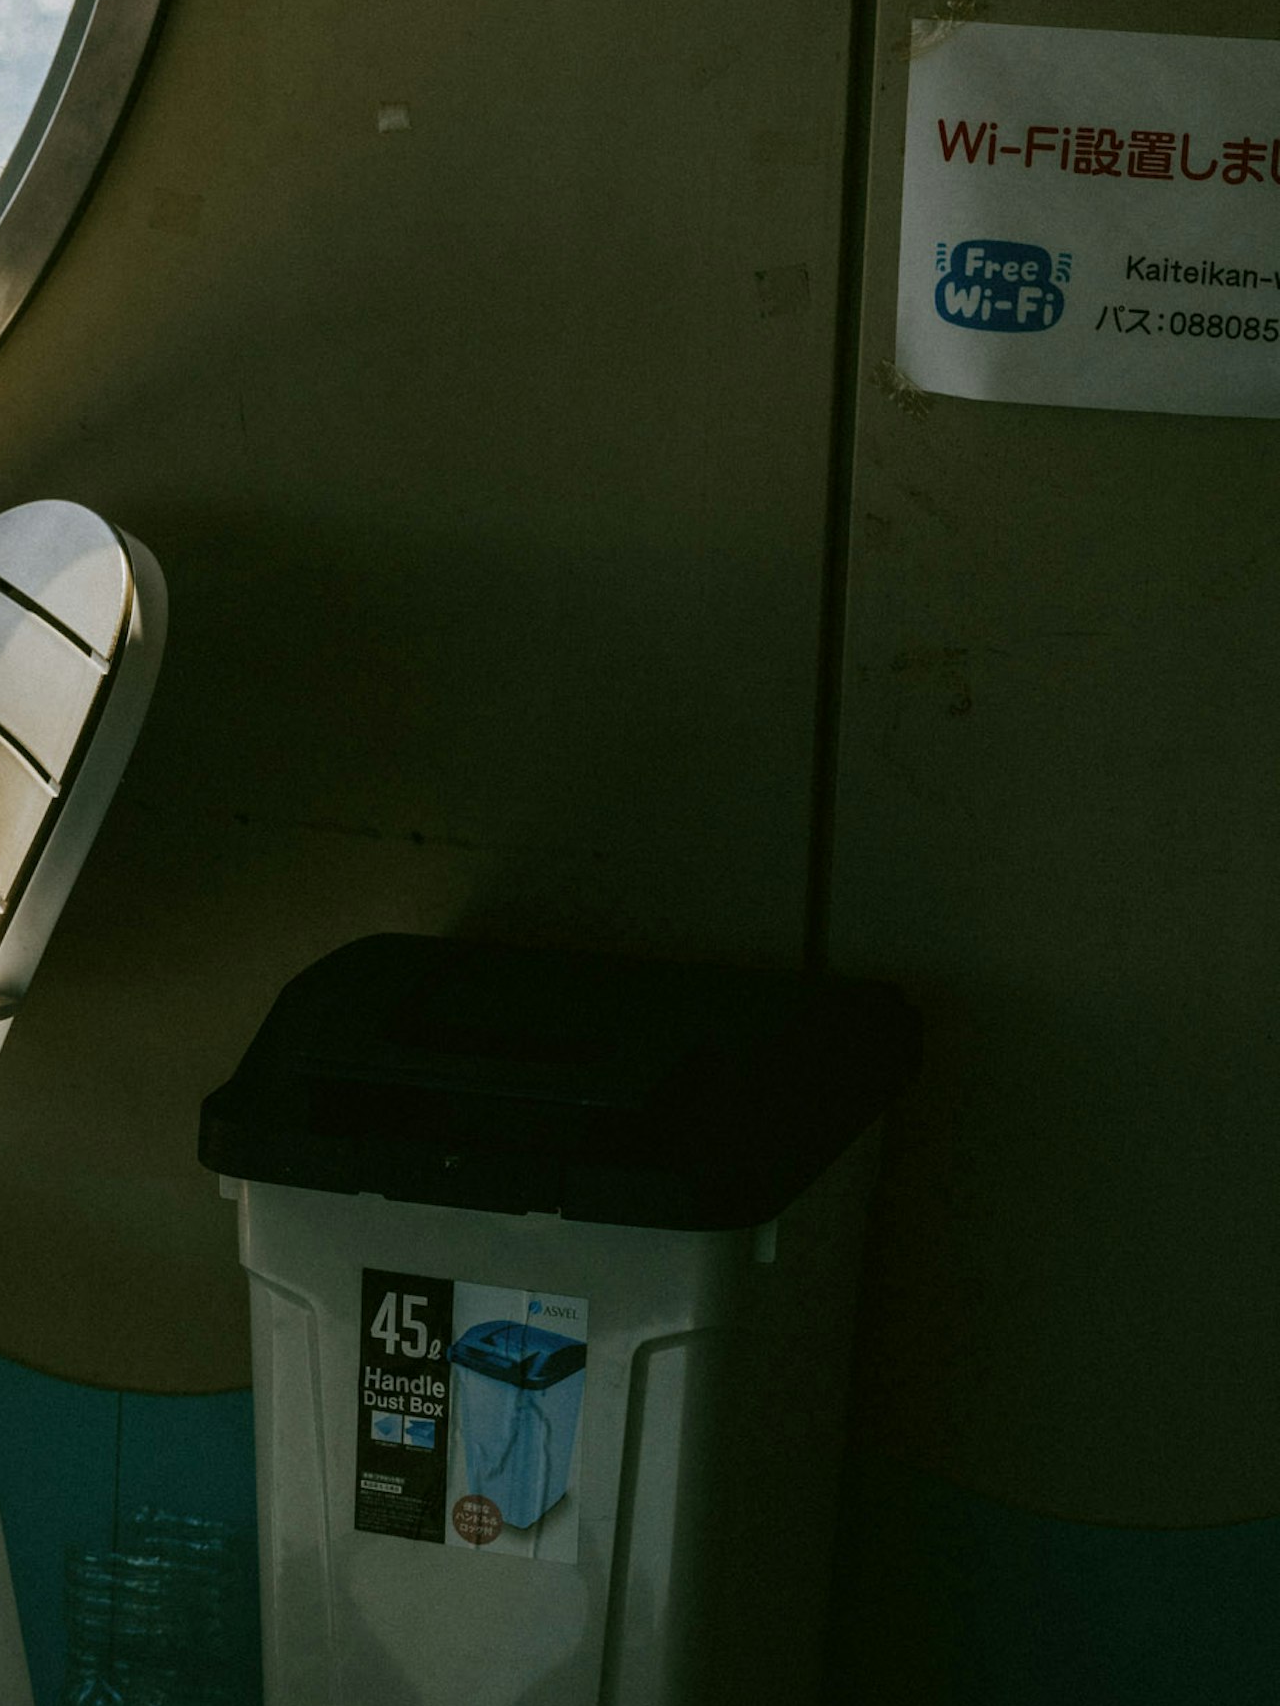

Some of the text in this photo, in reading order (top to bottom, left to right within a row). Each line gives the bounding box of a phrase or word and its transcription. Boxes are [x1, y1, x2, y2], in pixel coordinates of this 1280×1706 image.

[938, 119, 1280, 186] Wi-Fi設置しま
[965, 248, 1039, 282] Free
[944, 281, 1054, 326] Wi-Fi
[543, 1305, 579, 1321] ASVEL
[364, 1366, 446, 1399] Handle
[364, 1390, 444, 1418] Dust Box
